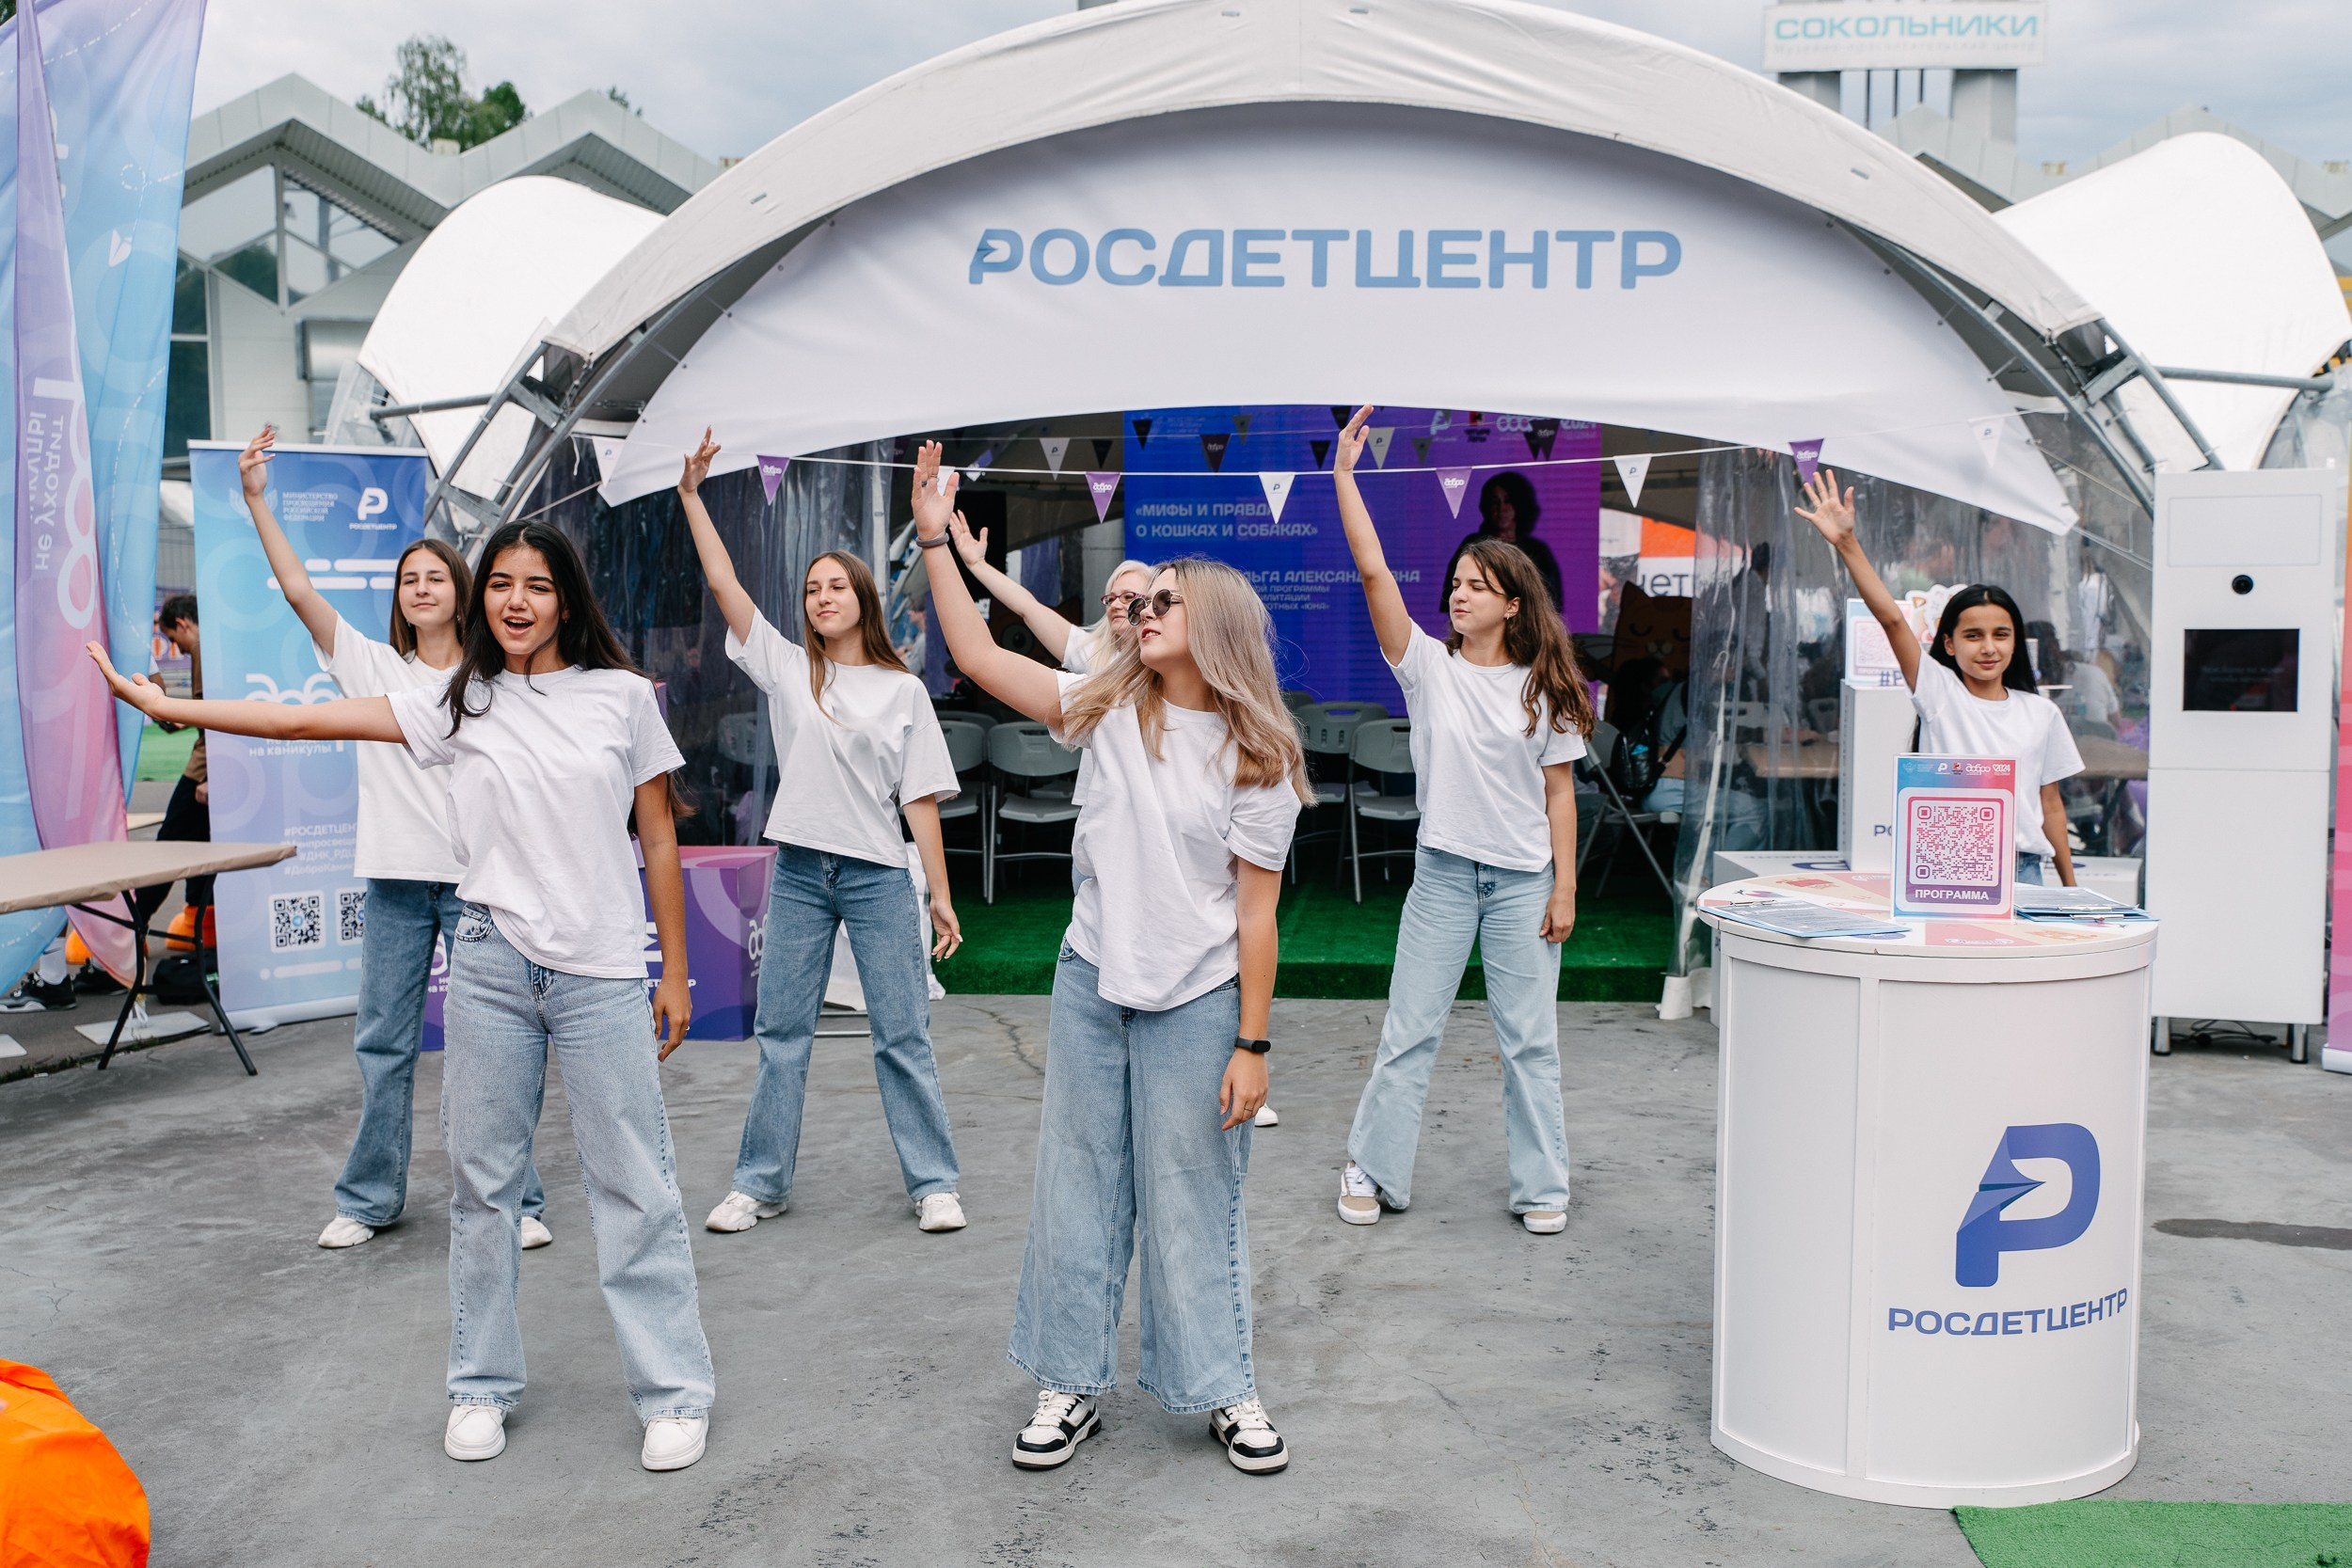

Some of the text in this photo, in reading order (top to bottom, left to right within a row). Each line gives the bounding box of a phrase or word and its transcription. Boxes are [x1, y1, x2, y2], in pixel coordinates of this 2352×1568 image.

[1775, 15, 2039, 40] СОКОЛЬНИКИ
[968, 228, 1682, 290] РОСДЕТЦЕНТР
[1136, 504, 1192, 516] «МИФЫ
[1198, 504, 1207, 516] И
[1136, 524, 1318, 537] О КОШКАХ И СОБАКАХ»
[1270, 584, 1329, 594] ПРОГРАММЫ
[1263, 594, 1311, 603] ИЛИТАЦИИ
[267, 742, 331, 756] каникулы
[285, 824, 357, 836] #РОСДЕТЦЕН
[1915, 889, 1989, 900] ПРОГРАММА
[1888, 1288, 2128, 1336] РОСДЕТЦЕНТР
